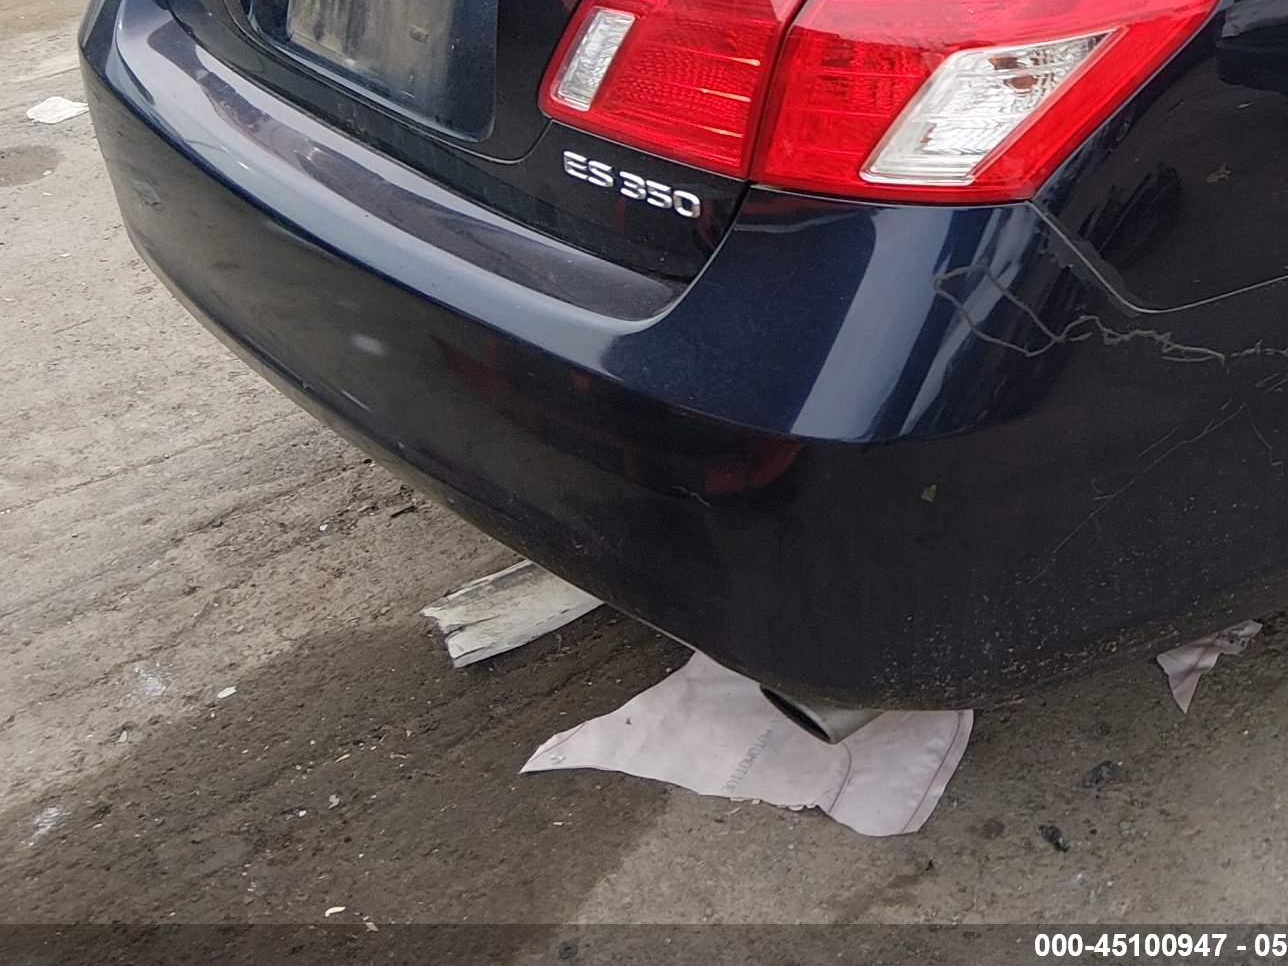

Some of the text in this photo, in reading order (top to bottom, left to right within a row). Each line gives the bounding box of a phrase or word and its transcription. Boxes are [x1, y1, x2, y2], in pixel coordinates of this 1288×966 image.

[563, 150, 702, 219] ES 350
[721, 729, 774, 794] AUTOMOTIVE
